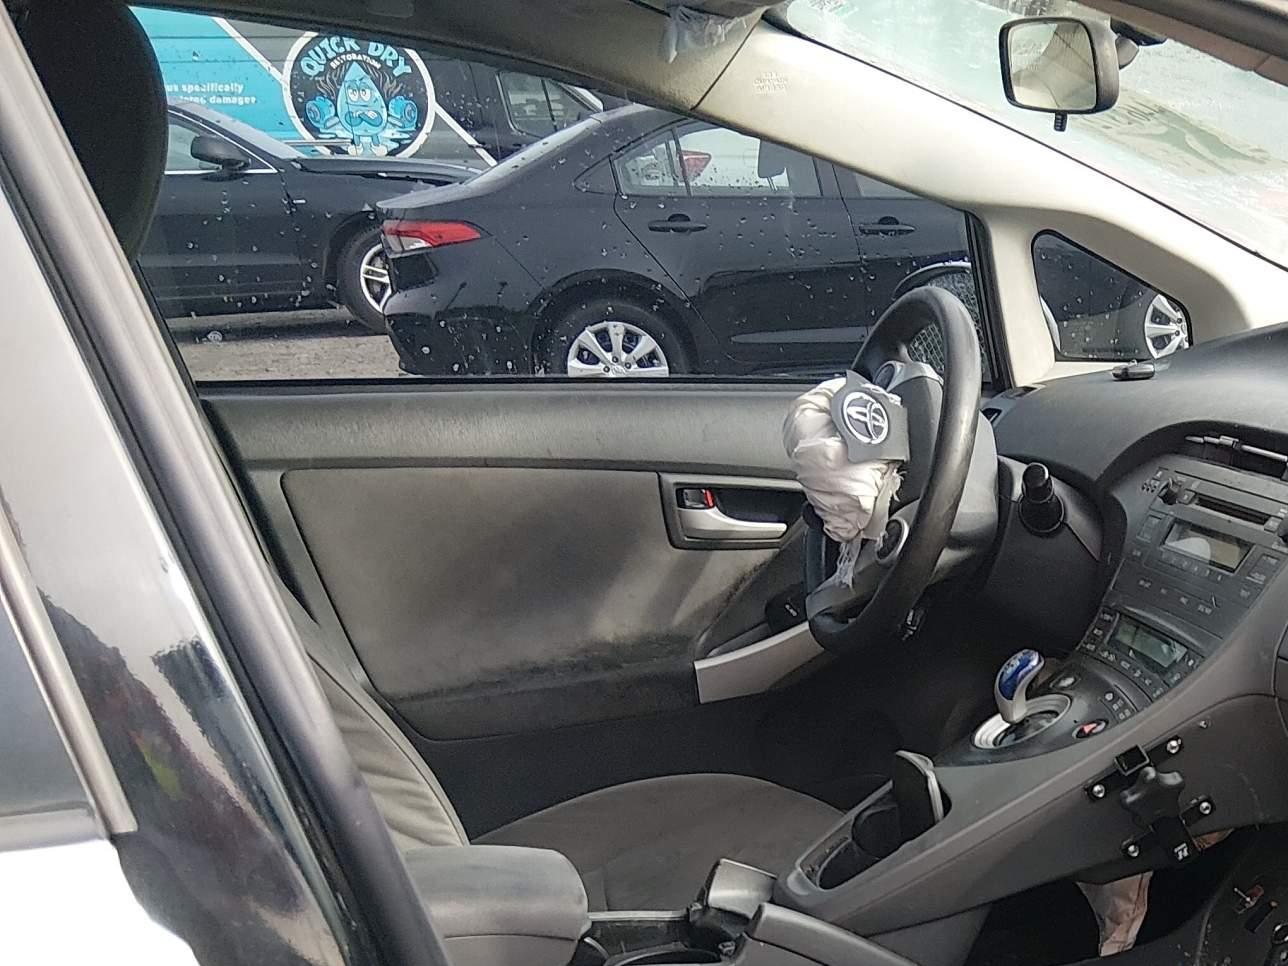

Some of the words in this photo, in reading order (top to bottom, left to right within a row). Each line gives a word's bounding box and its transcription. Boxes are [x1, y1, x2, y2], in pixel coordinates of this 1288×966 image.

[300, 36, 361, 77] QUICK
[367, 41, 413, 77] DRY
[181, 82, 244, 94] specifically
